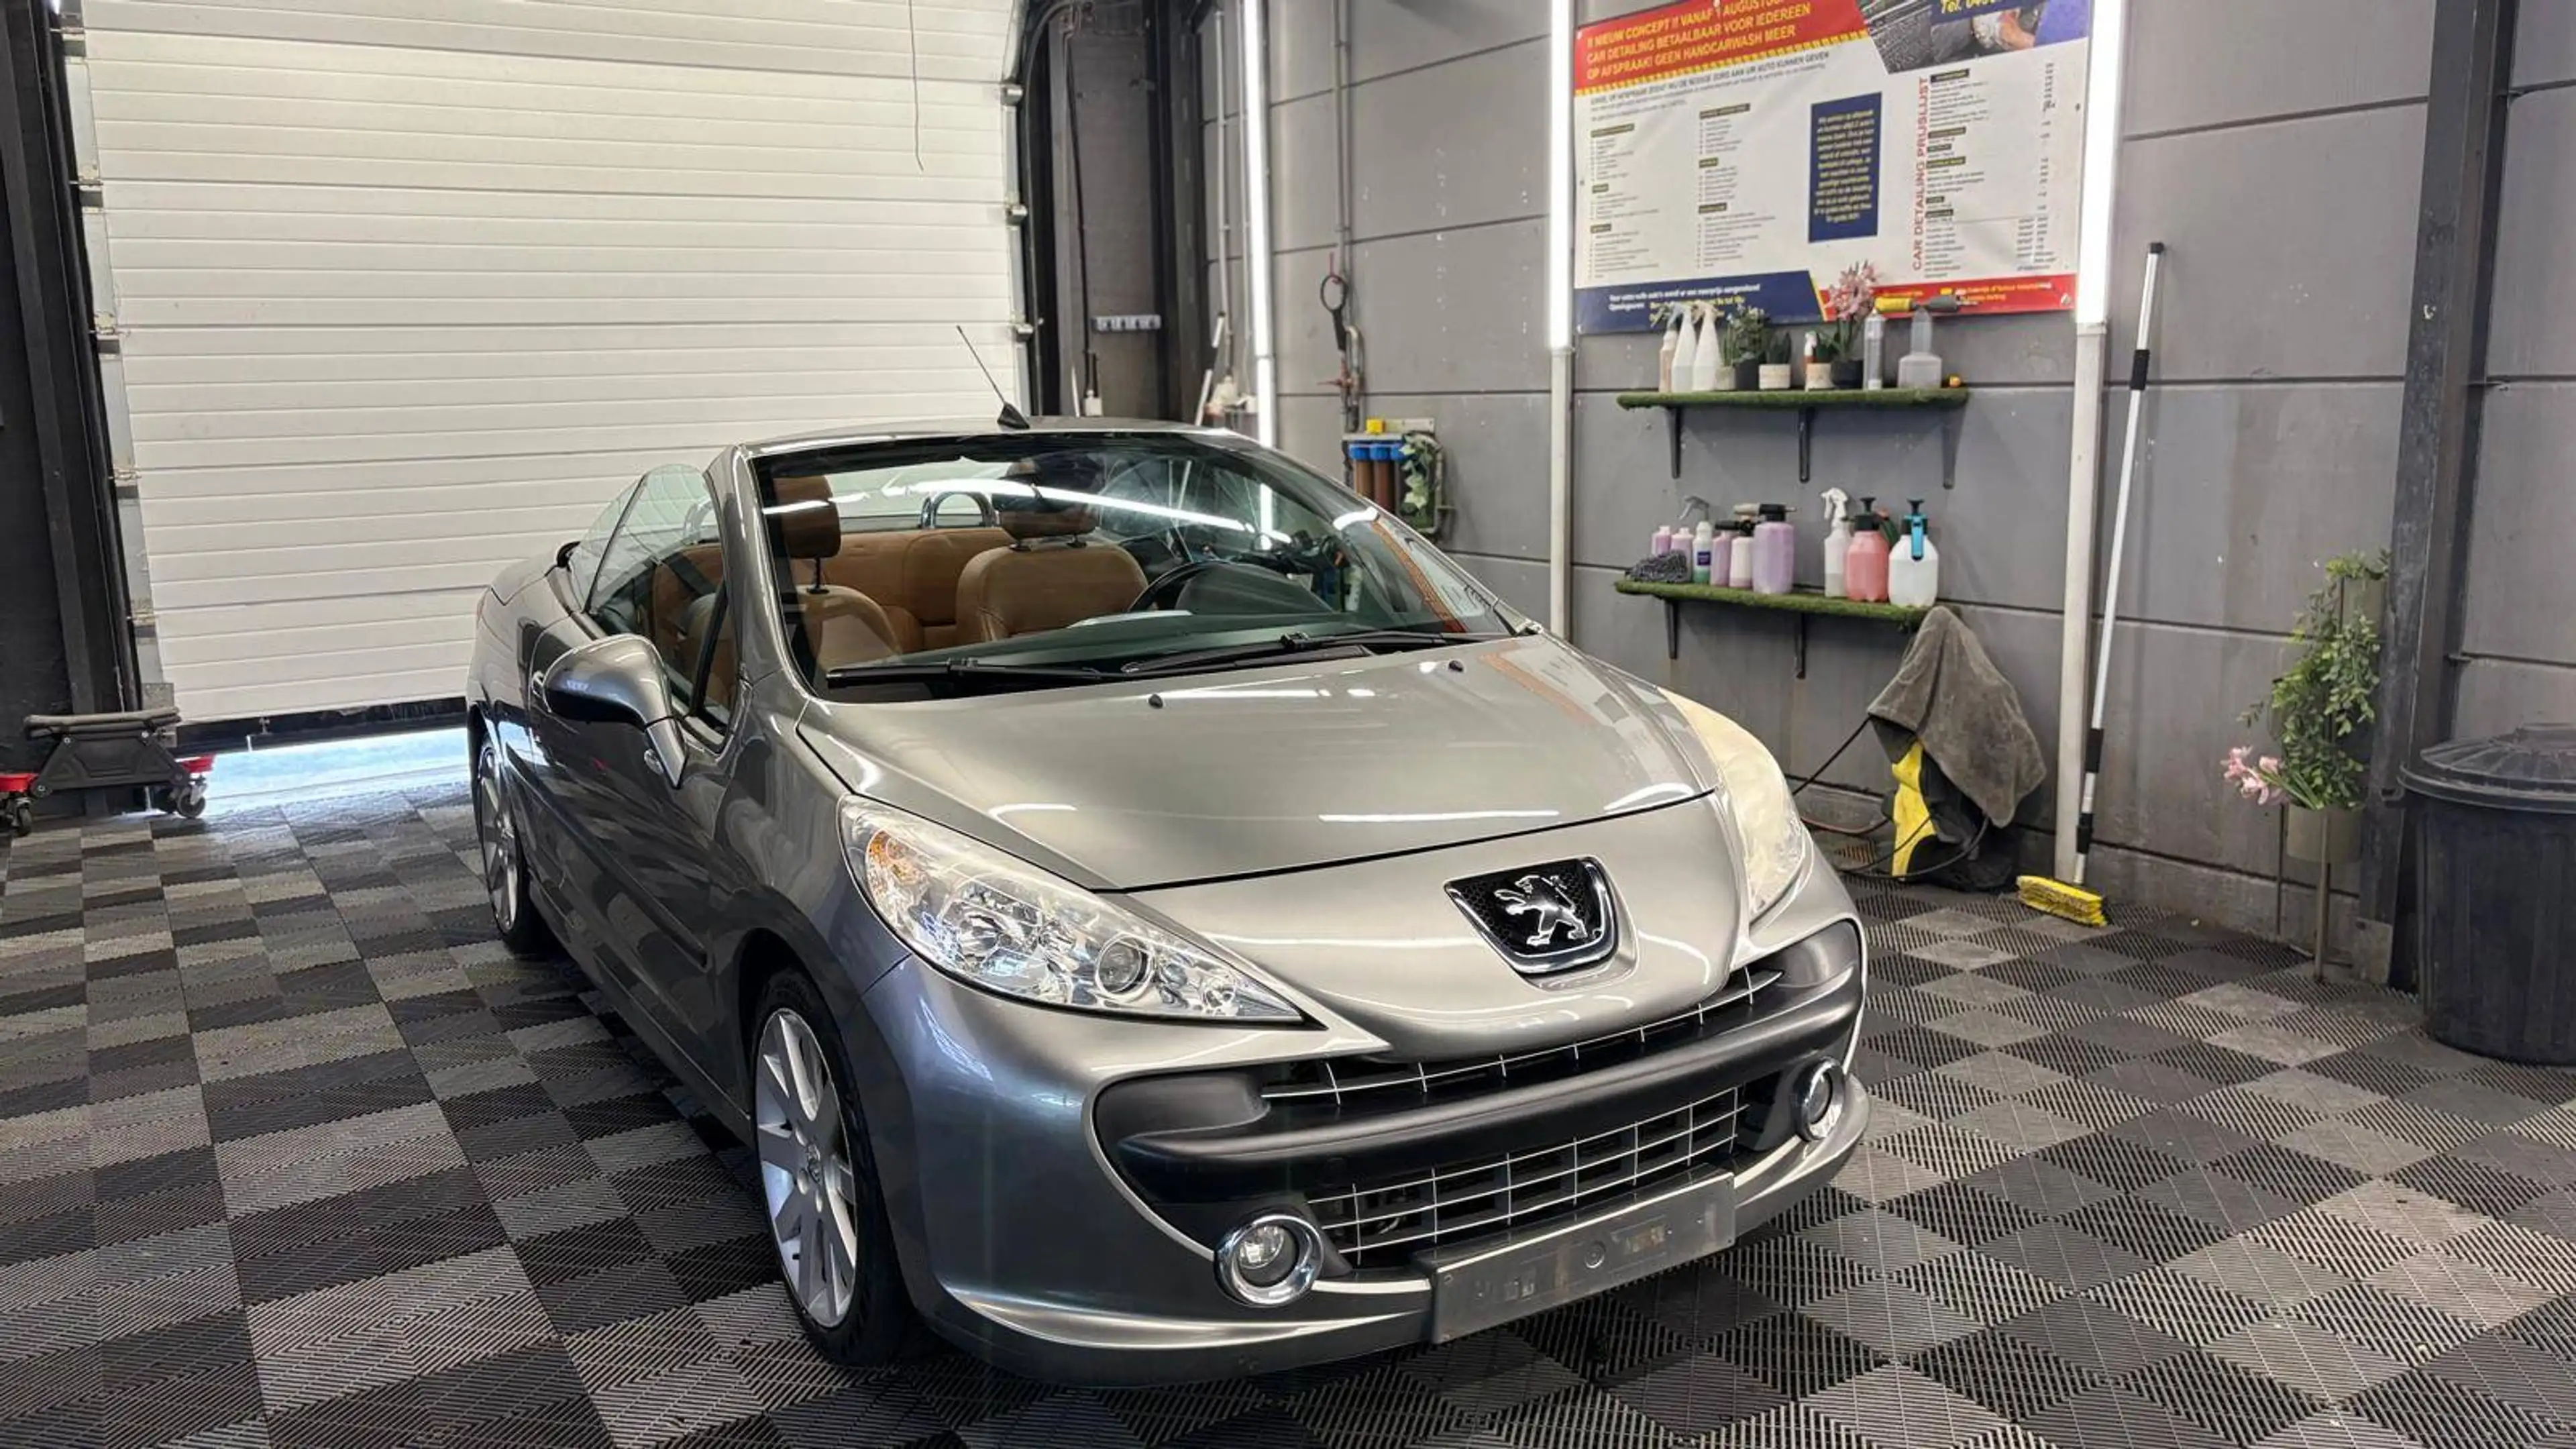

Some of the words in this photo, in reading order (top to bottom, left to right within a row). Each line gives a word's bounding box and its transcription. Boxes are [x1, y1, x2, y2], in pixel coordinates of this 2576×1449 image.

[1587, 50, 1607, 64] CAR
[1607, 38, 1655, 62] DETAILING
[1656, 23, 1722, 49] BETAALBAAR
[1723, 17, 1754, 32] VOOR
[1756, 3, 1811, 25] IEDEREEN
[1595, 32, 1625, 47] NIEUW
[1625, 19, 1669, 39] CONCEPT
[1680, 8, 1713, 26] VANAF
[1587, 67, 1599, 80] OP
[1655, 50, 1681, 66] GEEN
[1683, 32, 1764, 60] HANDCARWASH
[1765, 25, 1796, 43] MEER
[1758, 61, 1775, 72] AUTO
[1777, 56, 1805, 69] KUNNEN
[1806, 50, 1829, 64] GEVEN
[1914, 162, 1925, 235] DETAILING
[1913, 240, 1923, 270] CAR
